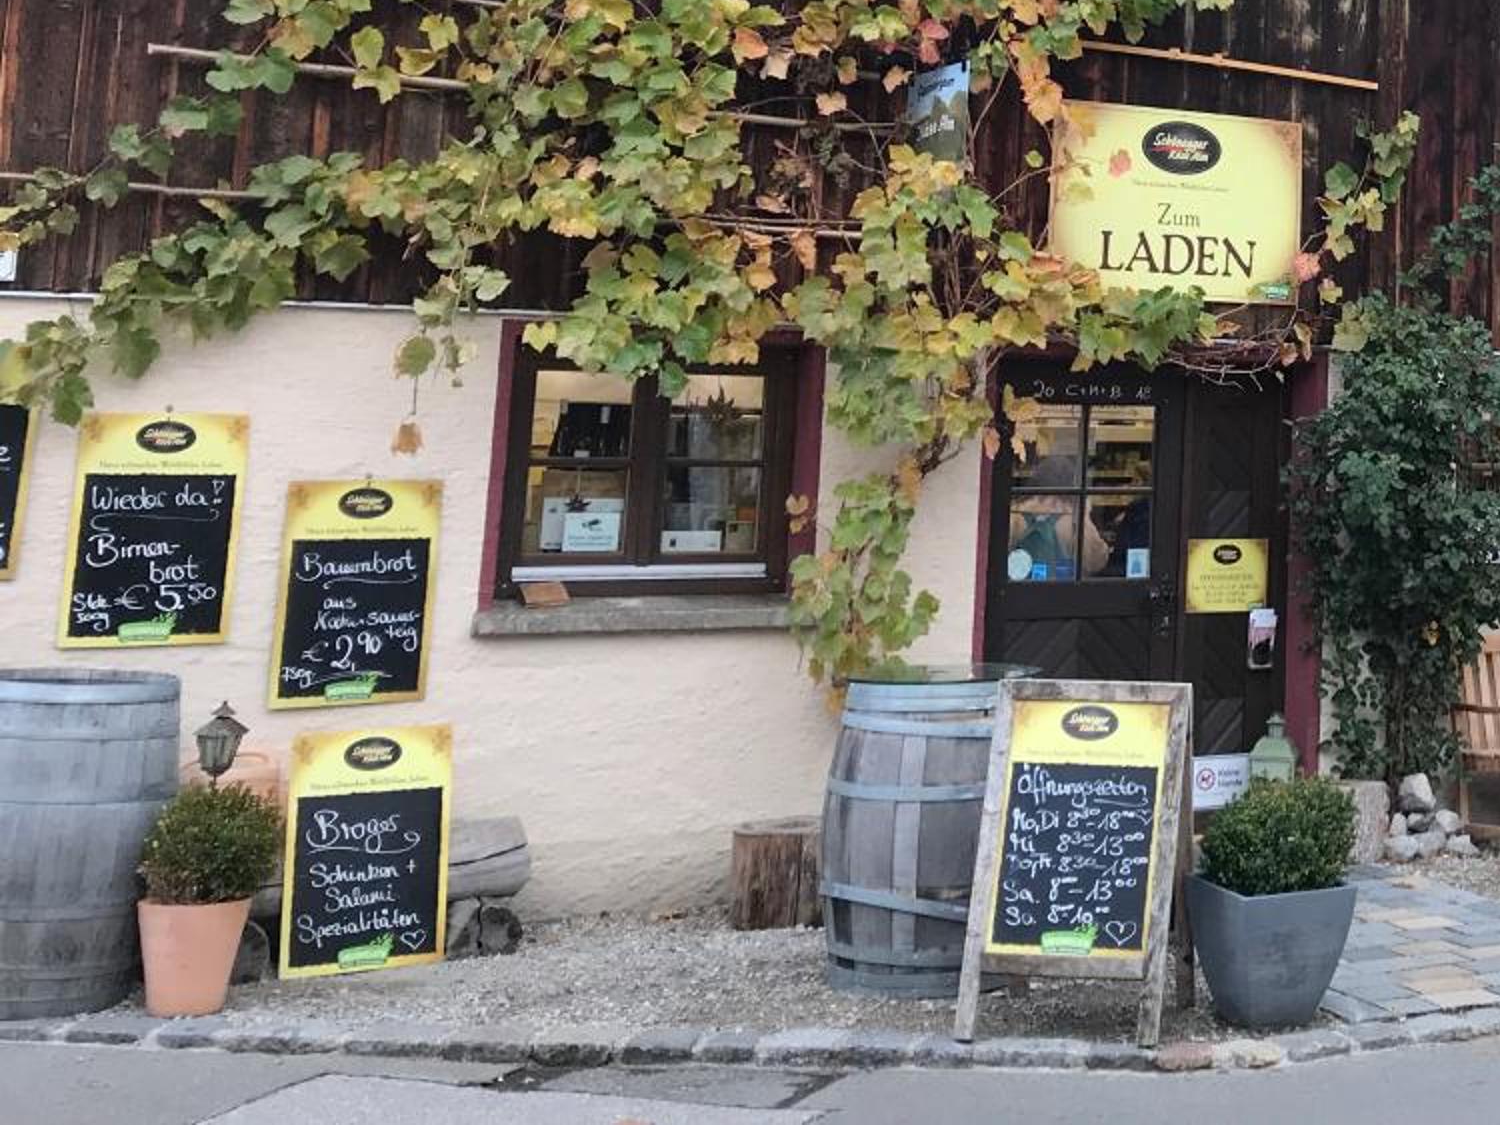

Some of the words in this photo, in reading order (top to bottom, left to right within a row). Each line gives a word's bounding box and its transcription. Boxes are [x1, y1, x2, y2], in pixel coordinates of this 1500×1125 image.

[1156, 202, 1201, 228] Zum
[1099, 230, 1257, 279] LADEN
[91, 486, 167, 510] Wieder
[149, 555, 199, 583] brot
[296, 549, 416, 582] Baumbrot
[323, 597, 357, 609] aus
[309, 863, 398, 888] Schinken
[325, 885, 395, 912] Salami
[1003, 880, 1040, 904] Sa.
[298, 909, 420, 949] Spezialitäten
